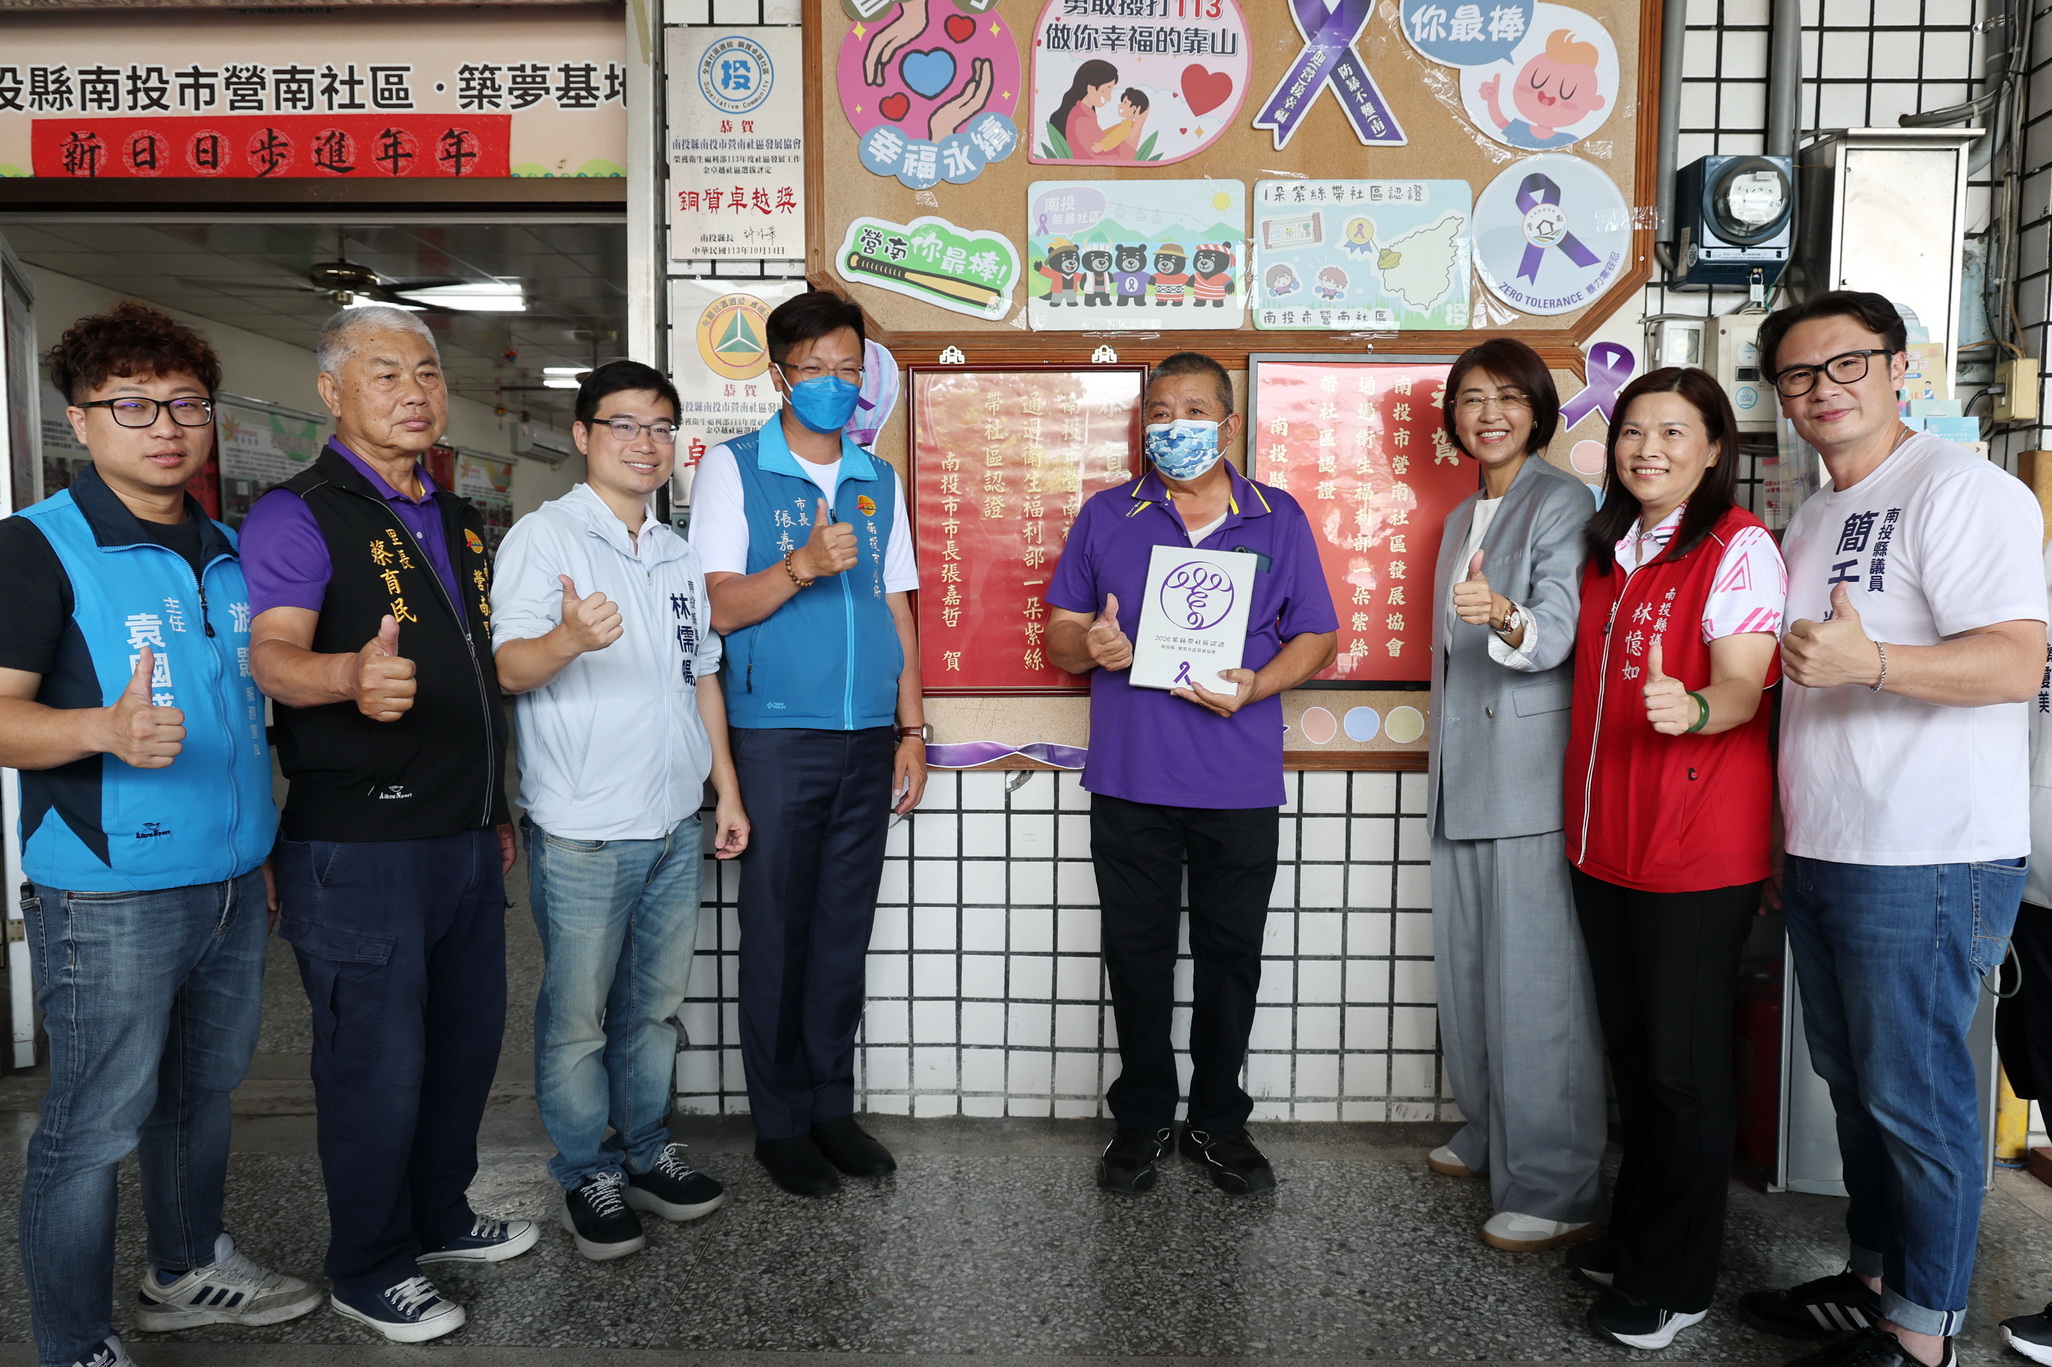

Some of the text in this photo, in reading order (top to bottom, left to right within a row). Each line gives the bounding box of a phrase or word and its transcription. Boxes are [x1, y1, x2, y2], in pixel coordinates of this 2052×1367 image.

[1046, 24, 1236, 54] 做你幸福的靠山
[1410, 4, 1526, 43] 你最棒
[742, 80, 769, 108] Community
[868, 115, 1012, 179] 幸福永續
[1045, 195, 1076, 212] 南投
[1052, 210, 1101, 225] 無暴社區
[1499, 281, 1584, 309] ZERO TOLERANCE
[1264, 310, 1387, 325] 南投市營南社區
[723, 384, 757, 397] 恭賀
[983, 391, 1007, 519] 帶社區認證
[1316, 374, 1339, 501] 帶社區認證
[794, 497, 811, 527] 市長
[1349, 376, 1378, 658] 通過衛生福利部一朵紫絲
[1385, 375, 1413, 658] 南投市營南社區發展協會
[385, 528, 415, 570] 里長
[774, 509, 796, 559] 張嘉
[1867, 507, 1901, 592] 南投縣議員
[369, 539, 418, 624] 蔡育民
[163, 596, 186, 633] 主任
[943, 650, 961, 672] 賀
[1622, 602, 1653, 681] 林憶如
